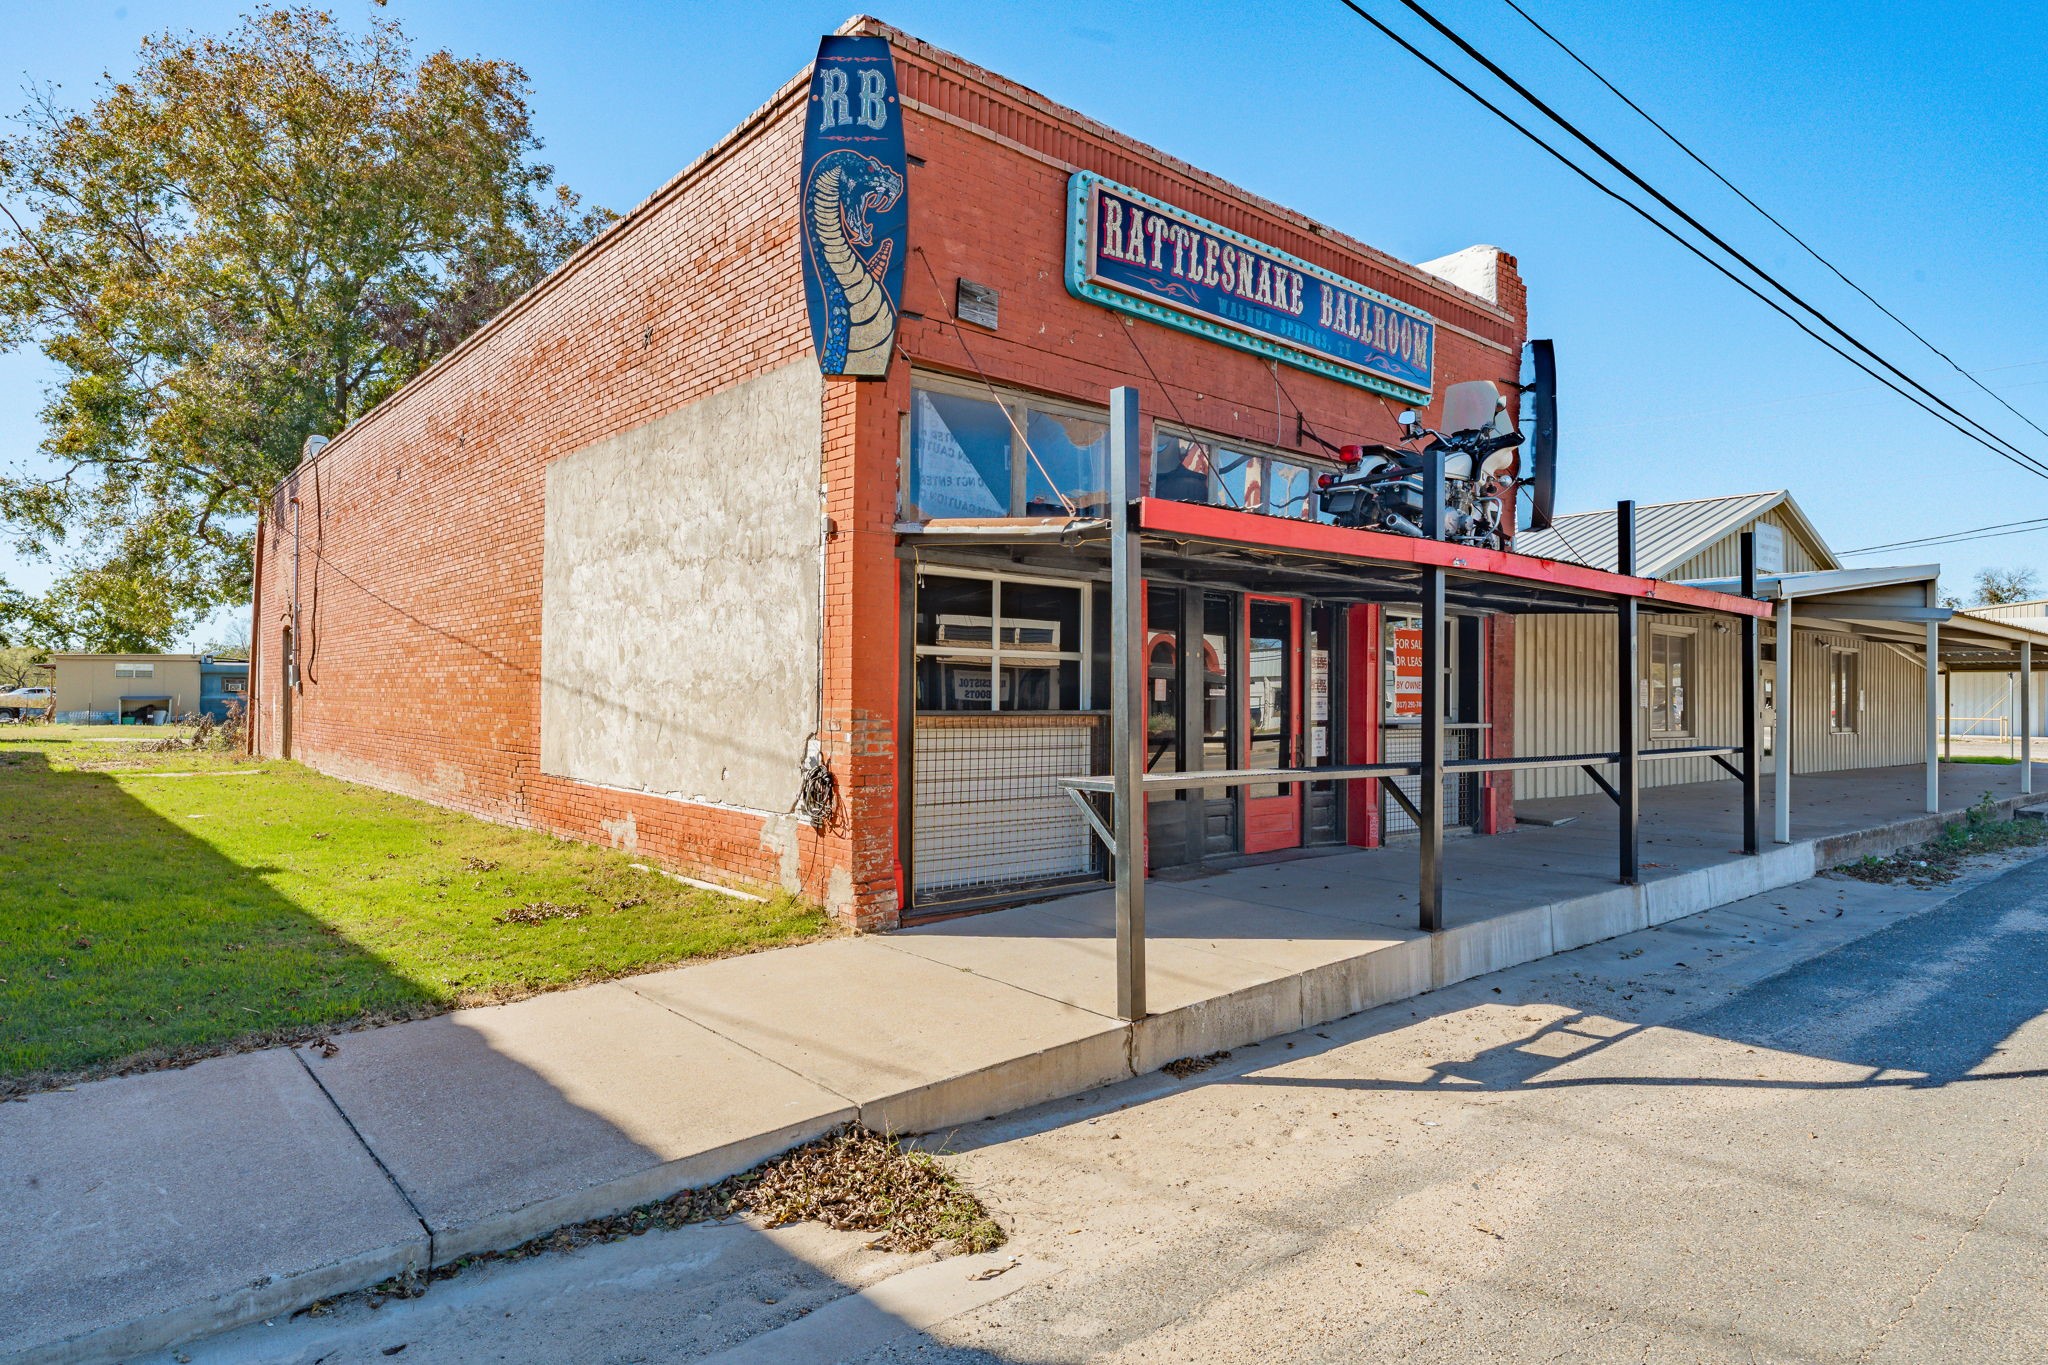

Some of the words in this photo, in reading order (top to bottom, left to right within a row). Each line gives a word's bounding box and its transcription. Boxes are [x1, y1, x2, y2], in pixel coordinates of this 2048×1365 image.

[1102, 196, 1304, 316] RATTLESNAKE
[1319, 284, 1430, 372] BALLROOM
[1218, 297, 1271, 329] WALNUT
[1396, 638, 1409, 650] FOR
[1411, 638, 1422, 650] SAL
[1396, 656, 1406, 667] OR
[1407, 656, 1422, 667] LEAS
[1404, 681, 1422, 690] OWNE
